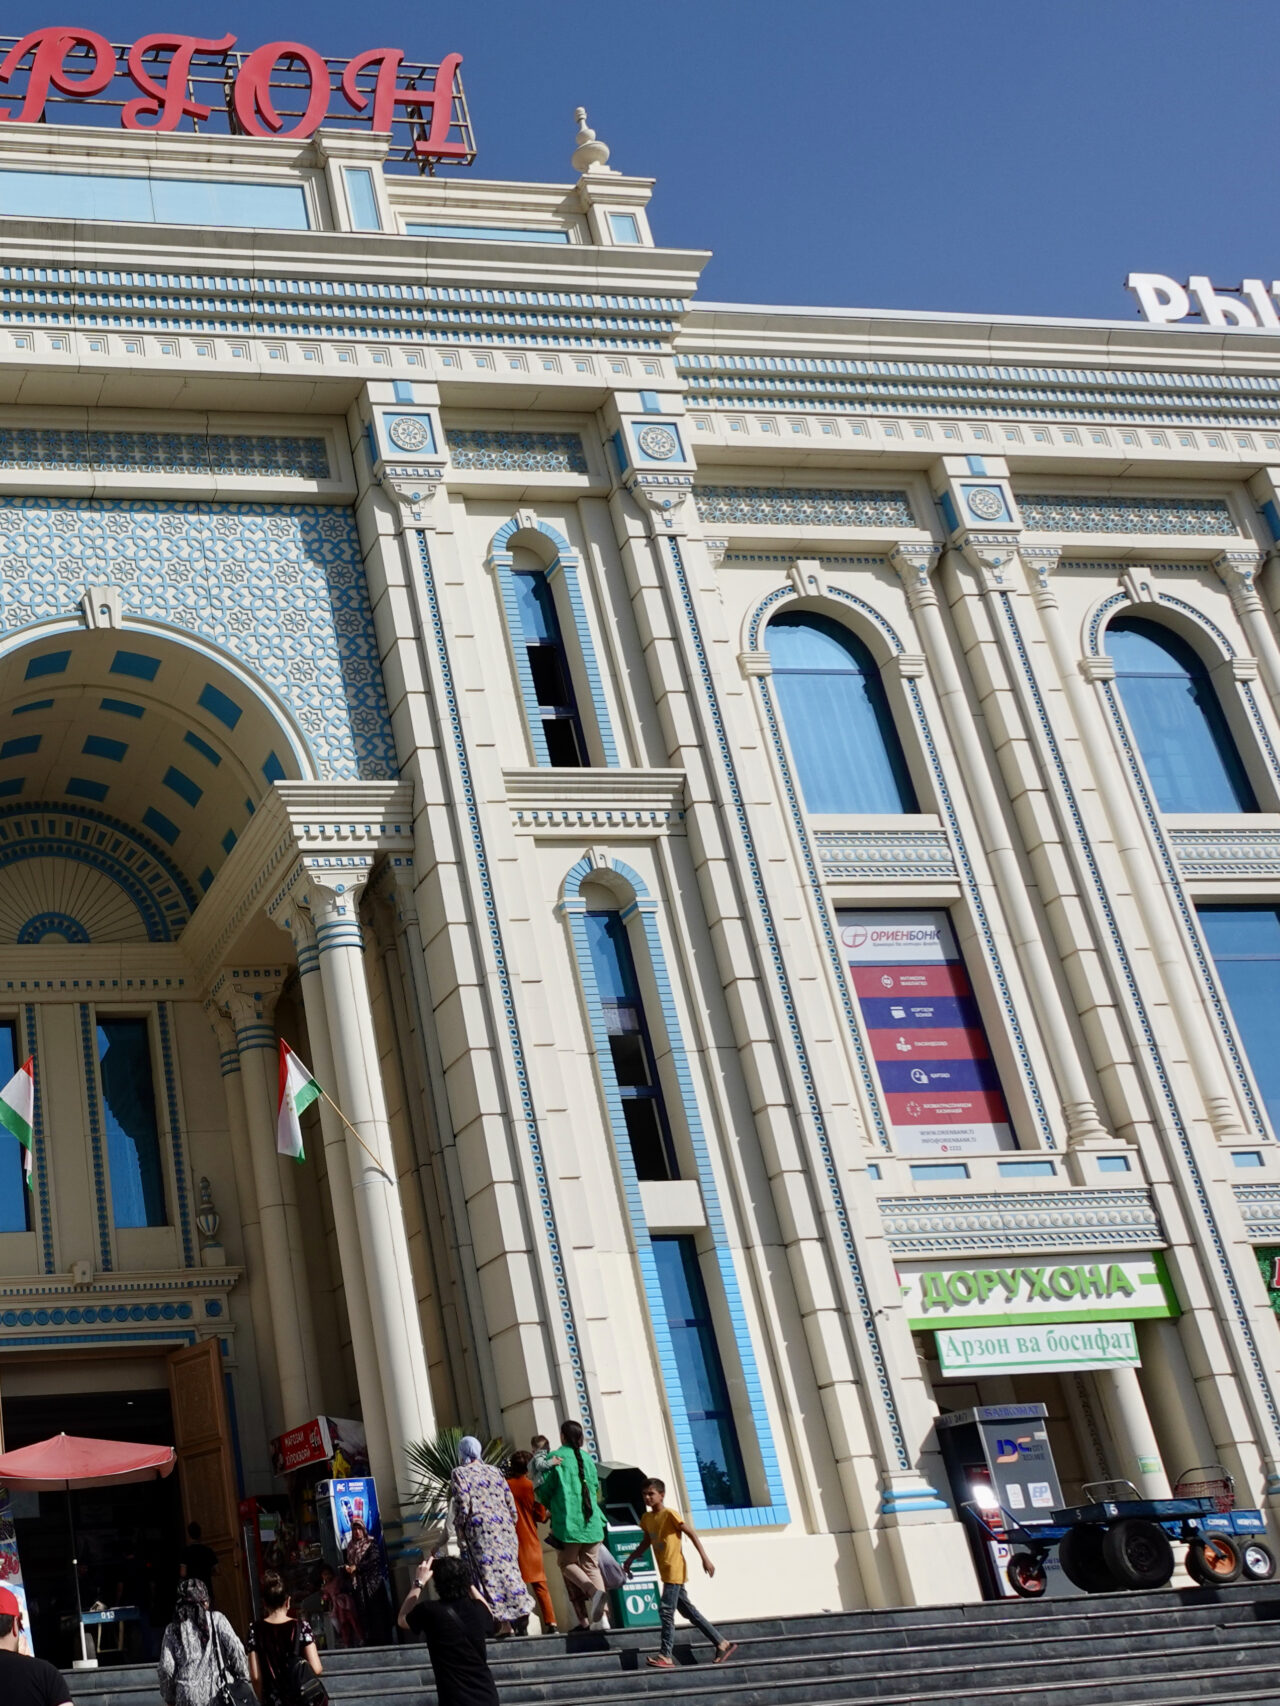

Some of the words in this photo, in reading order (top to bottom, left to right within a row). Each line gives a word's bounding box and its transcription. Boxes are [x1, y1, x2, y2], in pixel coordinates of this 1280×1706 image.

[1128, 272, 1280, 329] РЫ
[871, 930, 941, 942] ОРИЕНБОНК
[921, 1264, 1136, 1311] ДОРУХОНА
[946, 1335, 1010, 1363] Арзон
[1016, 1335, 1041, 1353] ва
[1046, 1328, 1132, 1355] босифат
[626, 1593, 658, 1615] 0%
